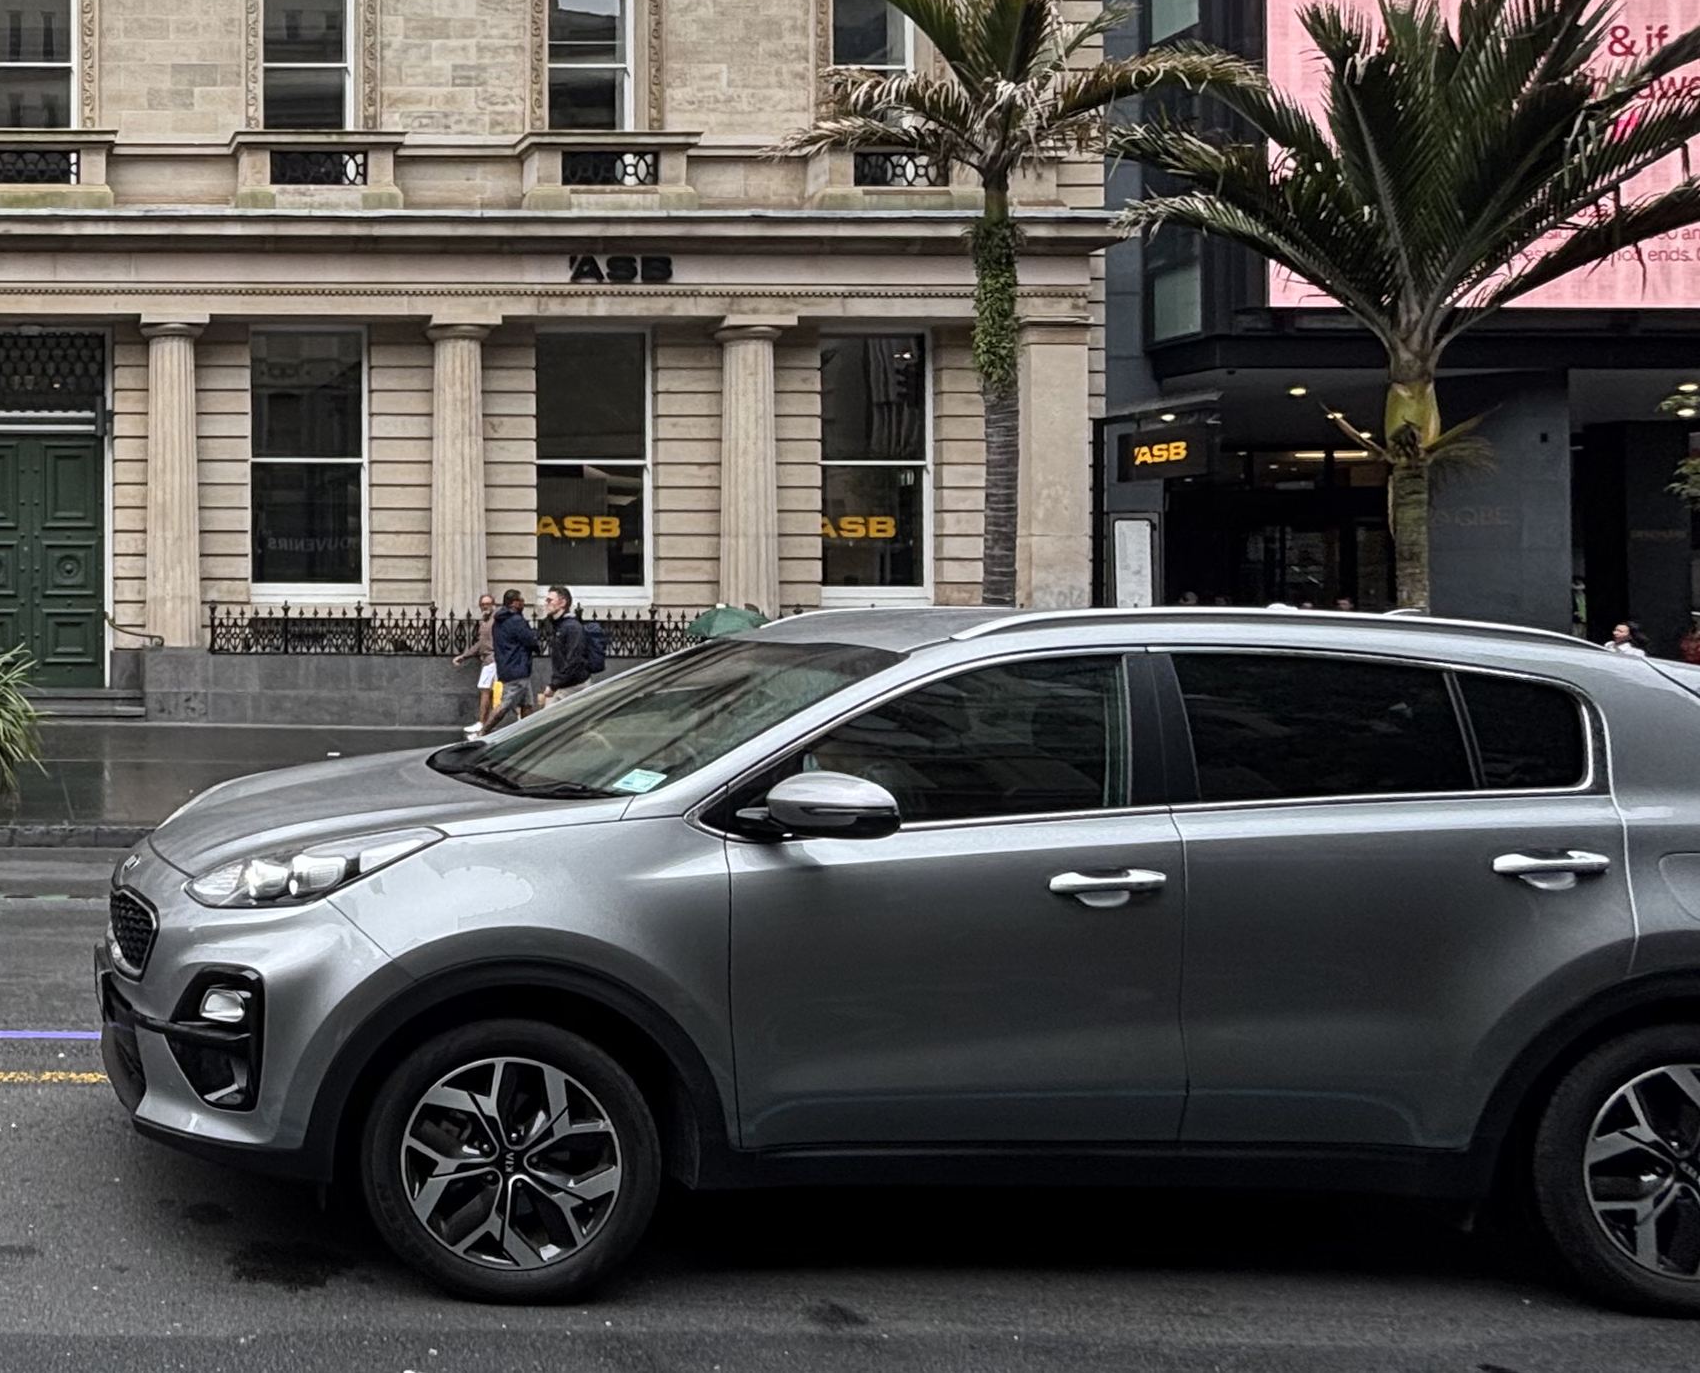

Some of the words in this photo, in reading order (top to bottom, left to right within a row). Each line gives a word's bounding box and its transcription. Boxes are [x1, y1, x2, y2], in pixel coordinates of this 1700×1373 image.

[1607, 25, 1637, 57] &
[569, 255, 673, 283] ASB
[1134, 440, 1188, 466] ASB
[537, 515, 621, 539] ASB
